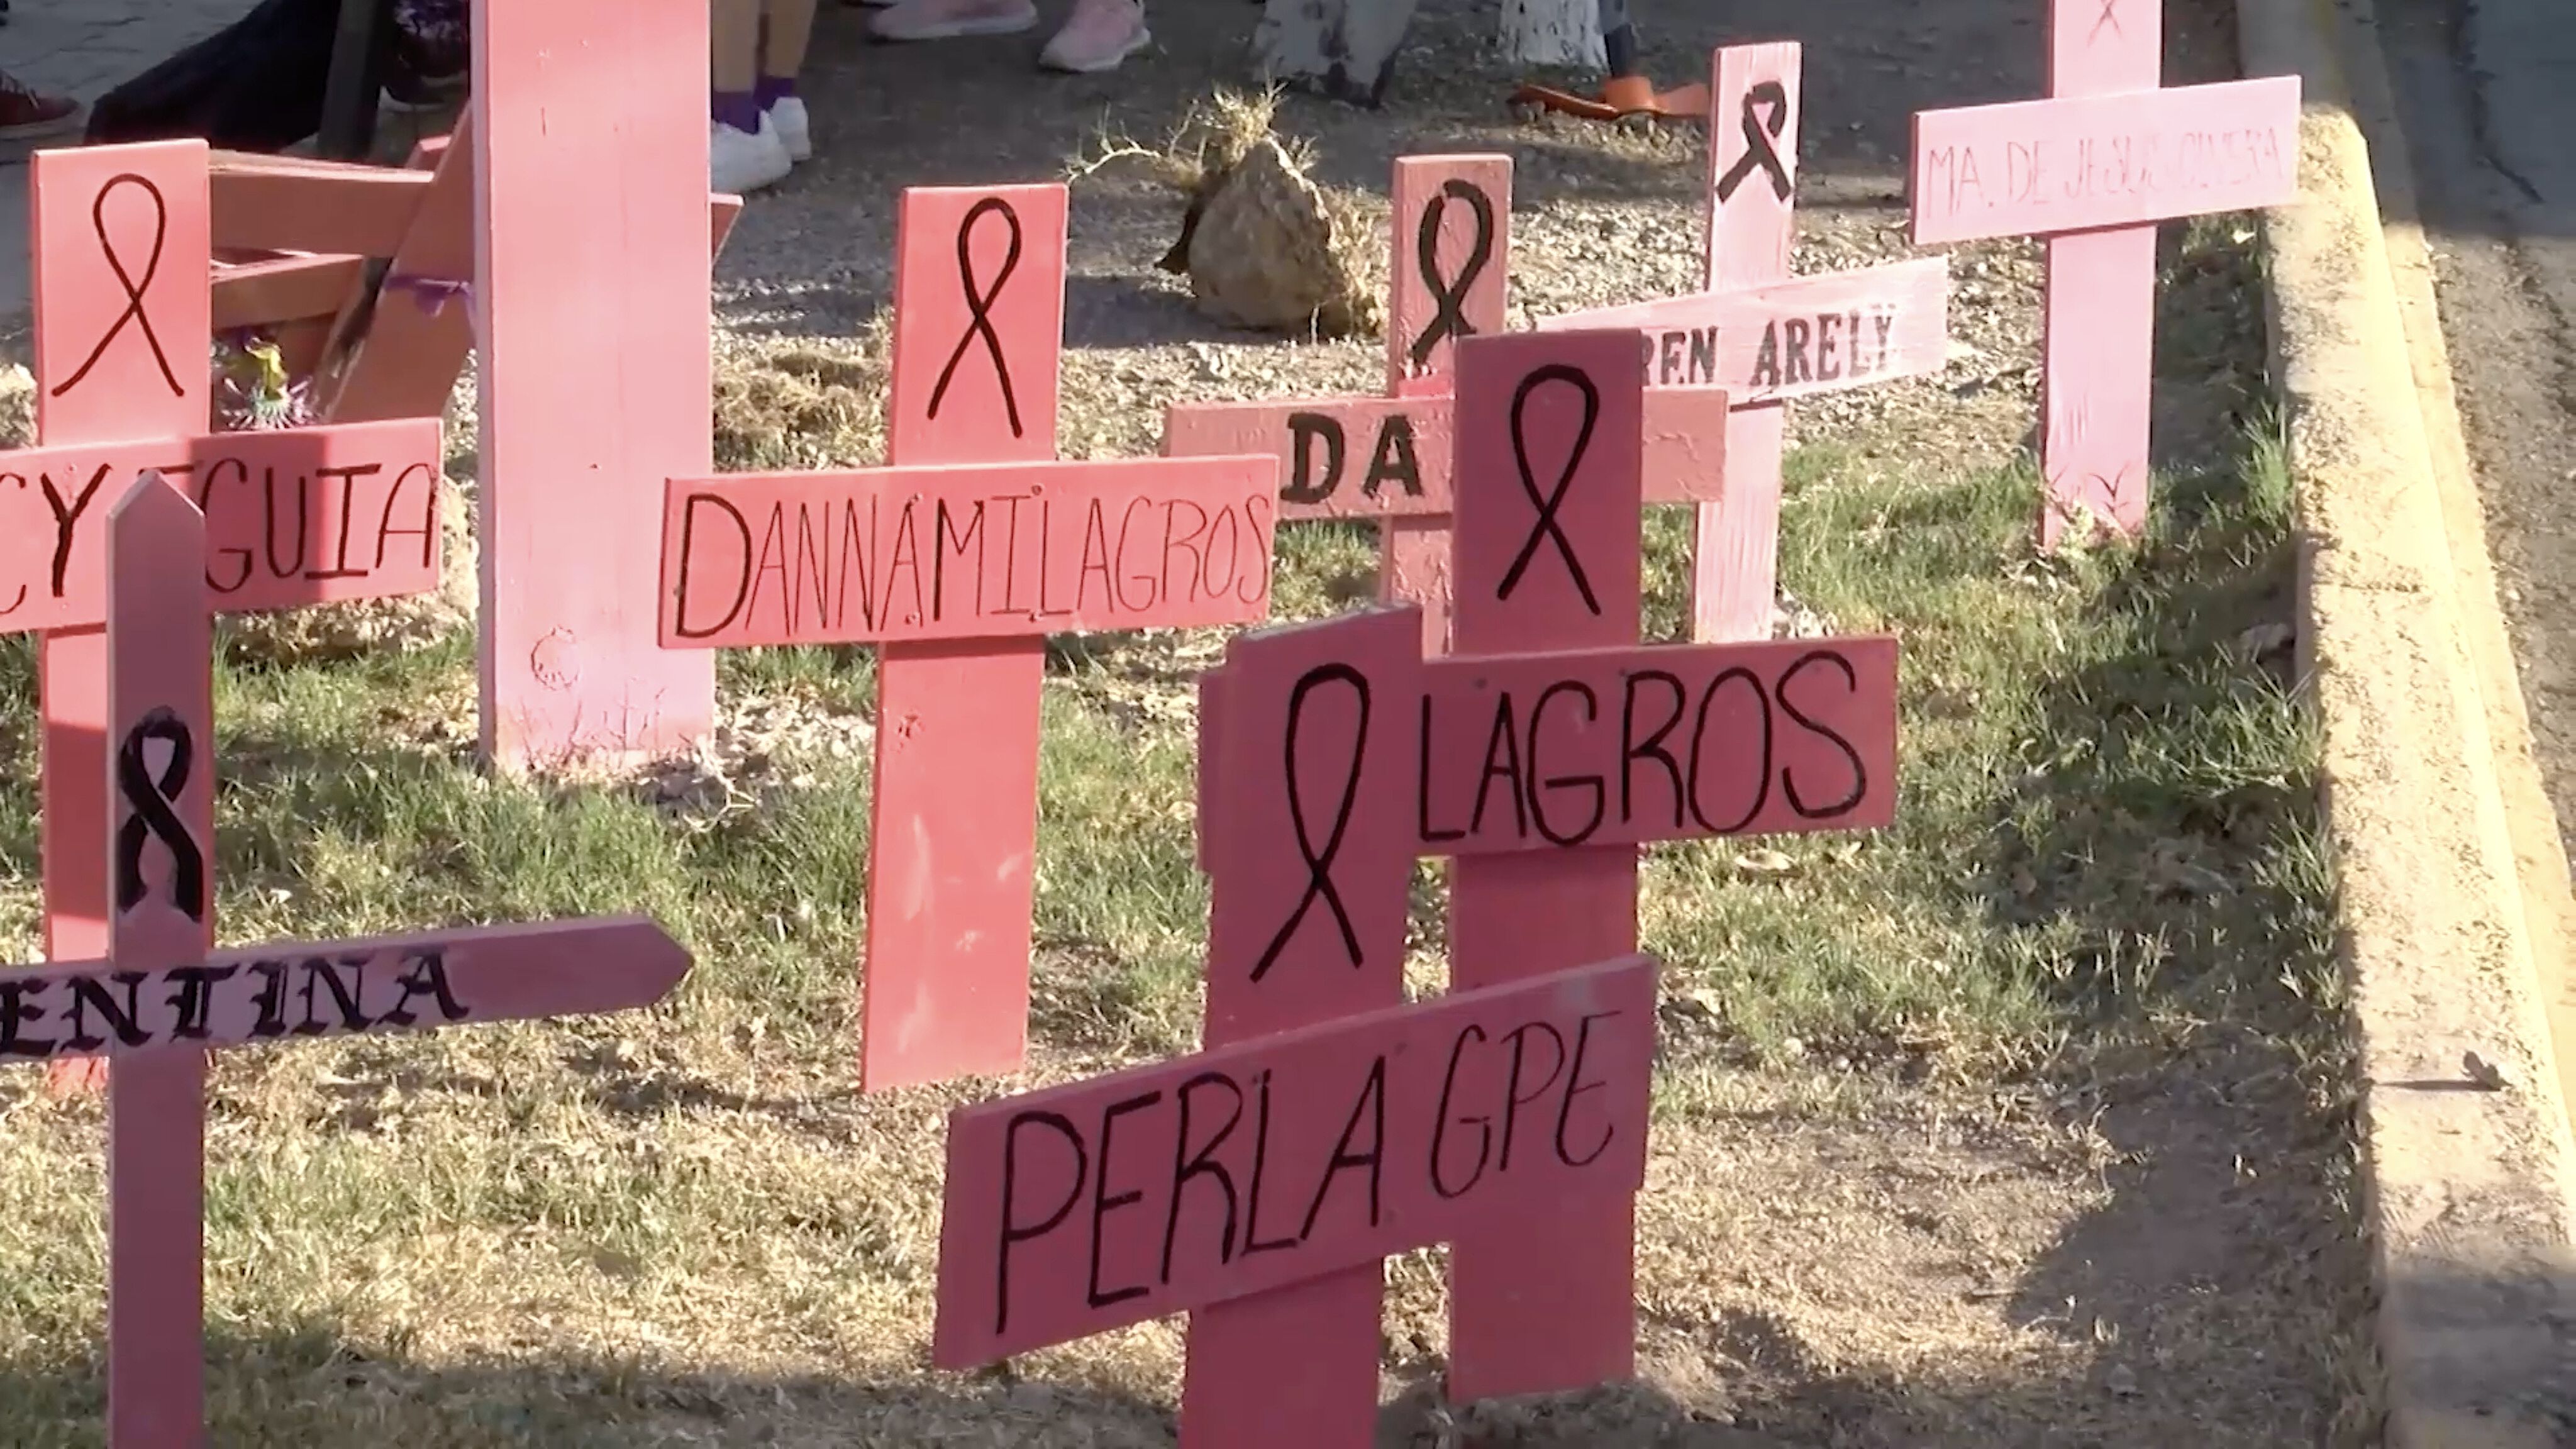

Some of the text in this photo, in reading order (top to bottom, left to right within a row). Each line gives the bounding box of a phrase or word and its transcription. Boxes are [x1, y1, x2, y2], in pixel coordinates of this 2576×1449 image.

[2007, 140, 2050, 204] DE
[1750, 302, 1897, 387] ARELY
[138, 458, 435, 593] GUIA
[0, 945, 471, 1057] ENTINA
[996, 1011, 1623, 1335] PERLA GPE
